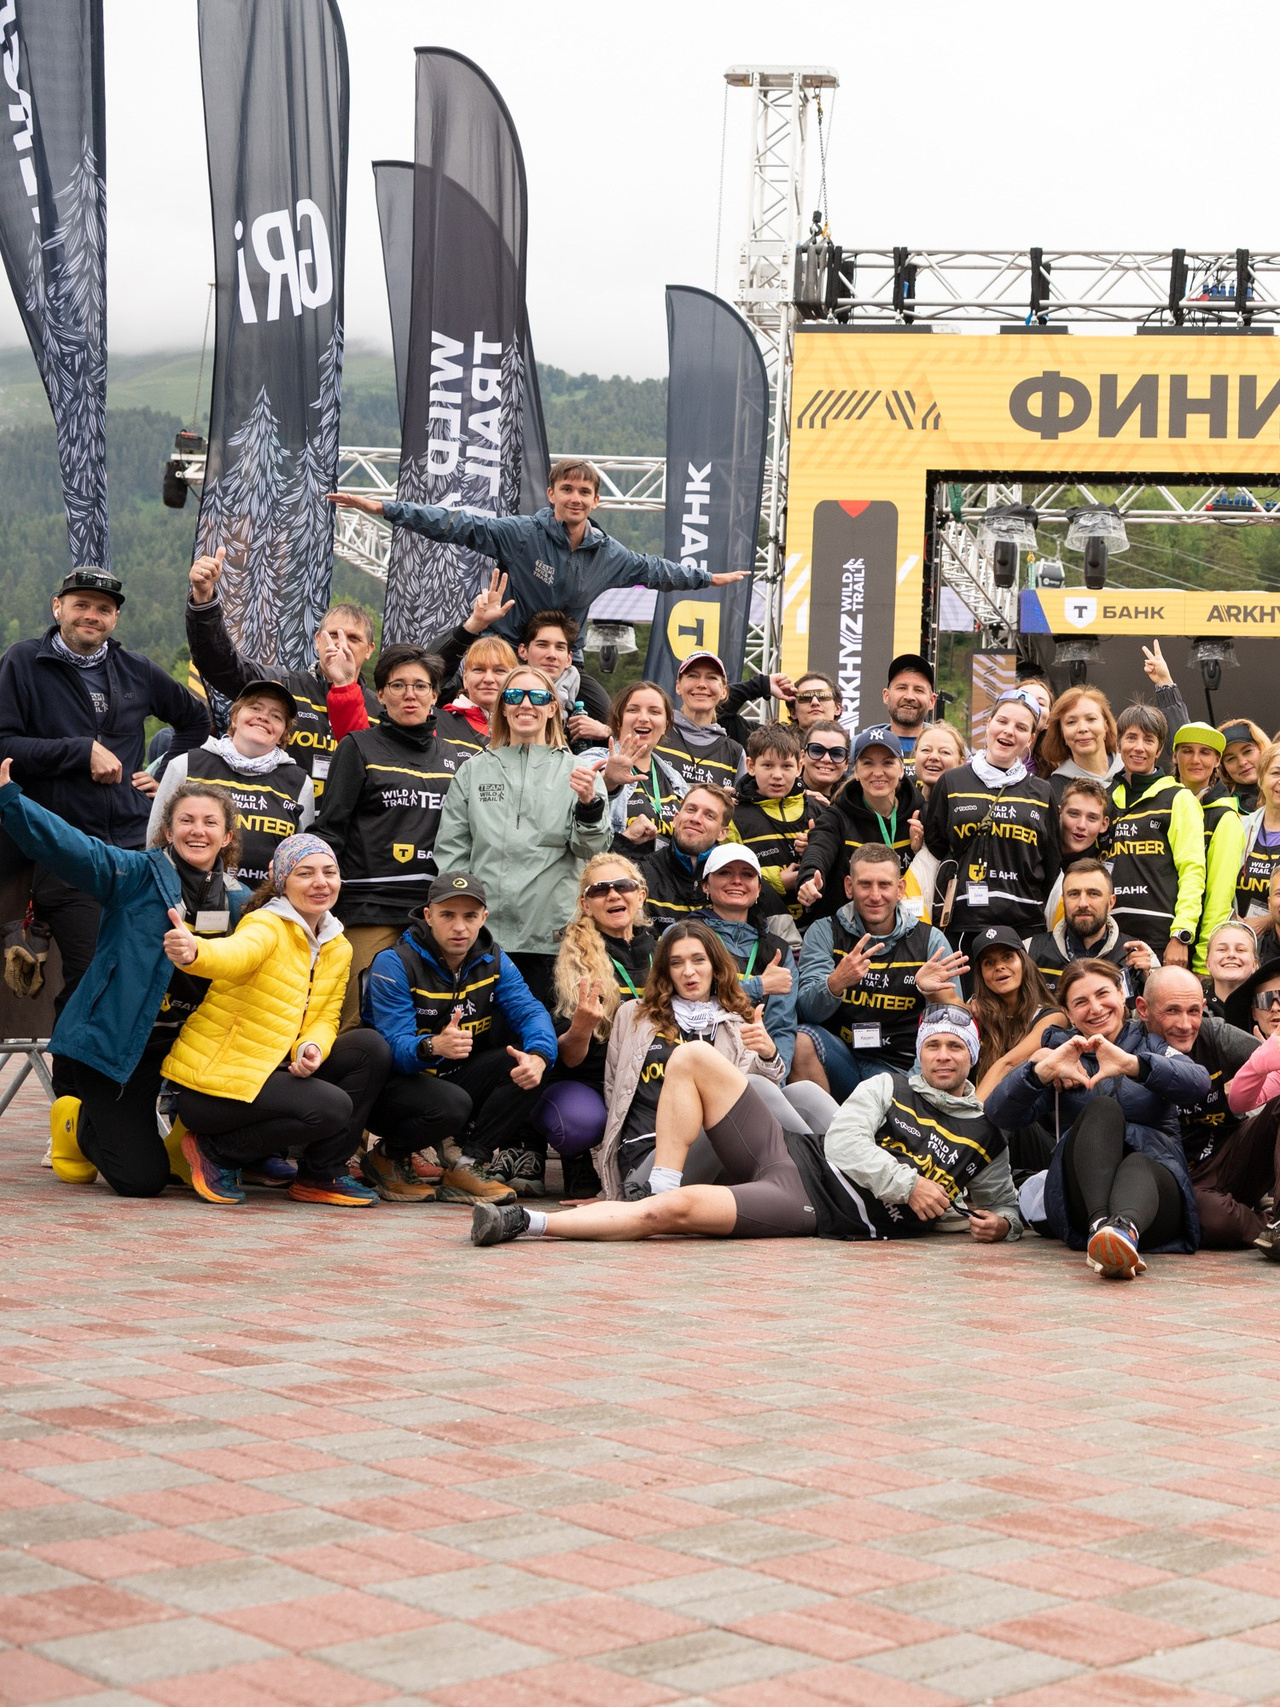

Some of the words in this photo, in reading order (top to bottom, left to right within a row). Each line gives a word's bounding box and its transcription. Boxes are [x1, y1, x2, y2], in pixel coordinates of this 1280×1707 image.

[841, 573, 853, 612] WILD
[852, 571, 865, 612] TRAIL
[1103, 605, 1165, 620] БАНК
[682, 763, 705, 775] WILD
[682, 770, 707, 783] TRAIL
[232, 792, 256, 803] WILD
[381, 789, 409, 800] WILD
[382, 798, 410, 808] TRAIL
[990, 811, 1009, 819] RAIL
[235, 813, 296, 838] NTEER
[953, 821, 1038, 847] VONTEER
[1249, 866, 1271, 875] TRAIL
[1251, 861, 1271, 869] WILD
[1114, 885, 1149, 895] БАНК
[930, 1132, 950, 1154] WILD
[927, 1140, 947, 1164] TRAIL
